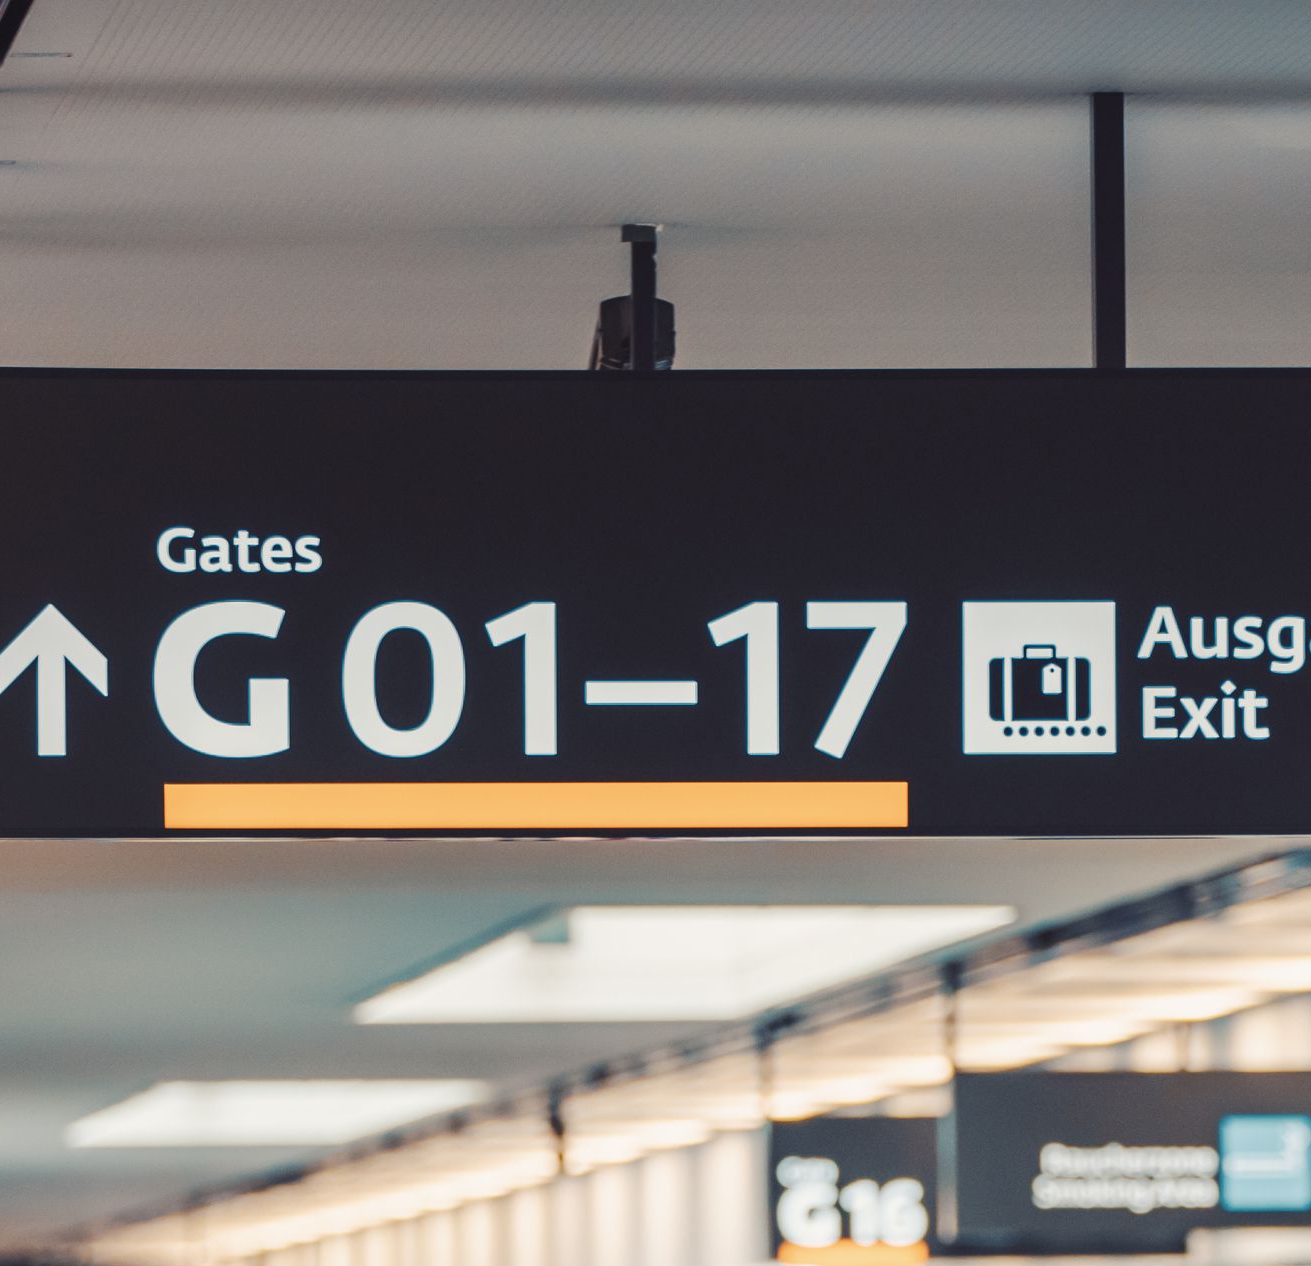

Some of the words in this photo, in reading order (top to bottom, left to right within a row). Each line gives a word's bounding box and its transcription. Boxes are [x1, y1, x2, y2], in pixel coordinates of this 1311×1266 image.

[156, 527, 323, 573] Gates
[153, 601, 290, 758] G
[1142, 680, 1270, 740] Exit
[777, 1182, 842, 1247] G
[840, 1178, 929, 1246] 16
